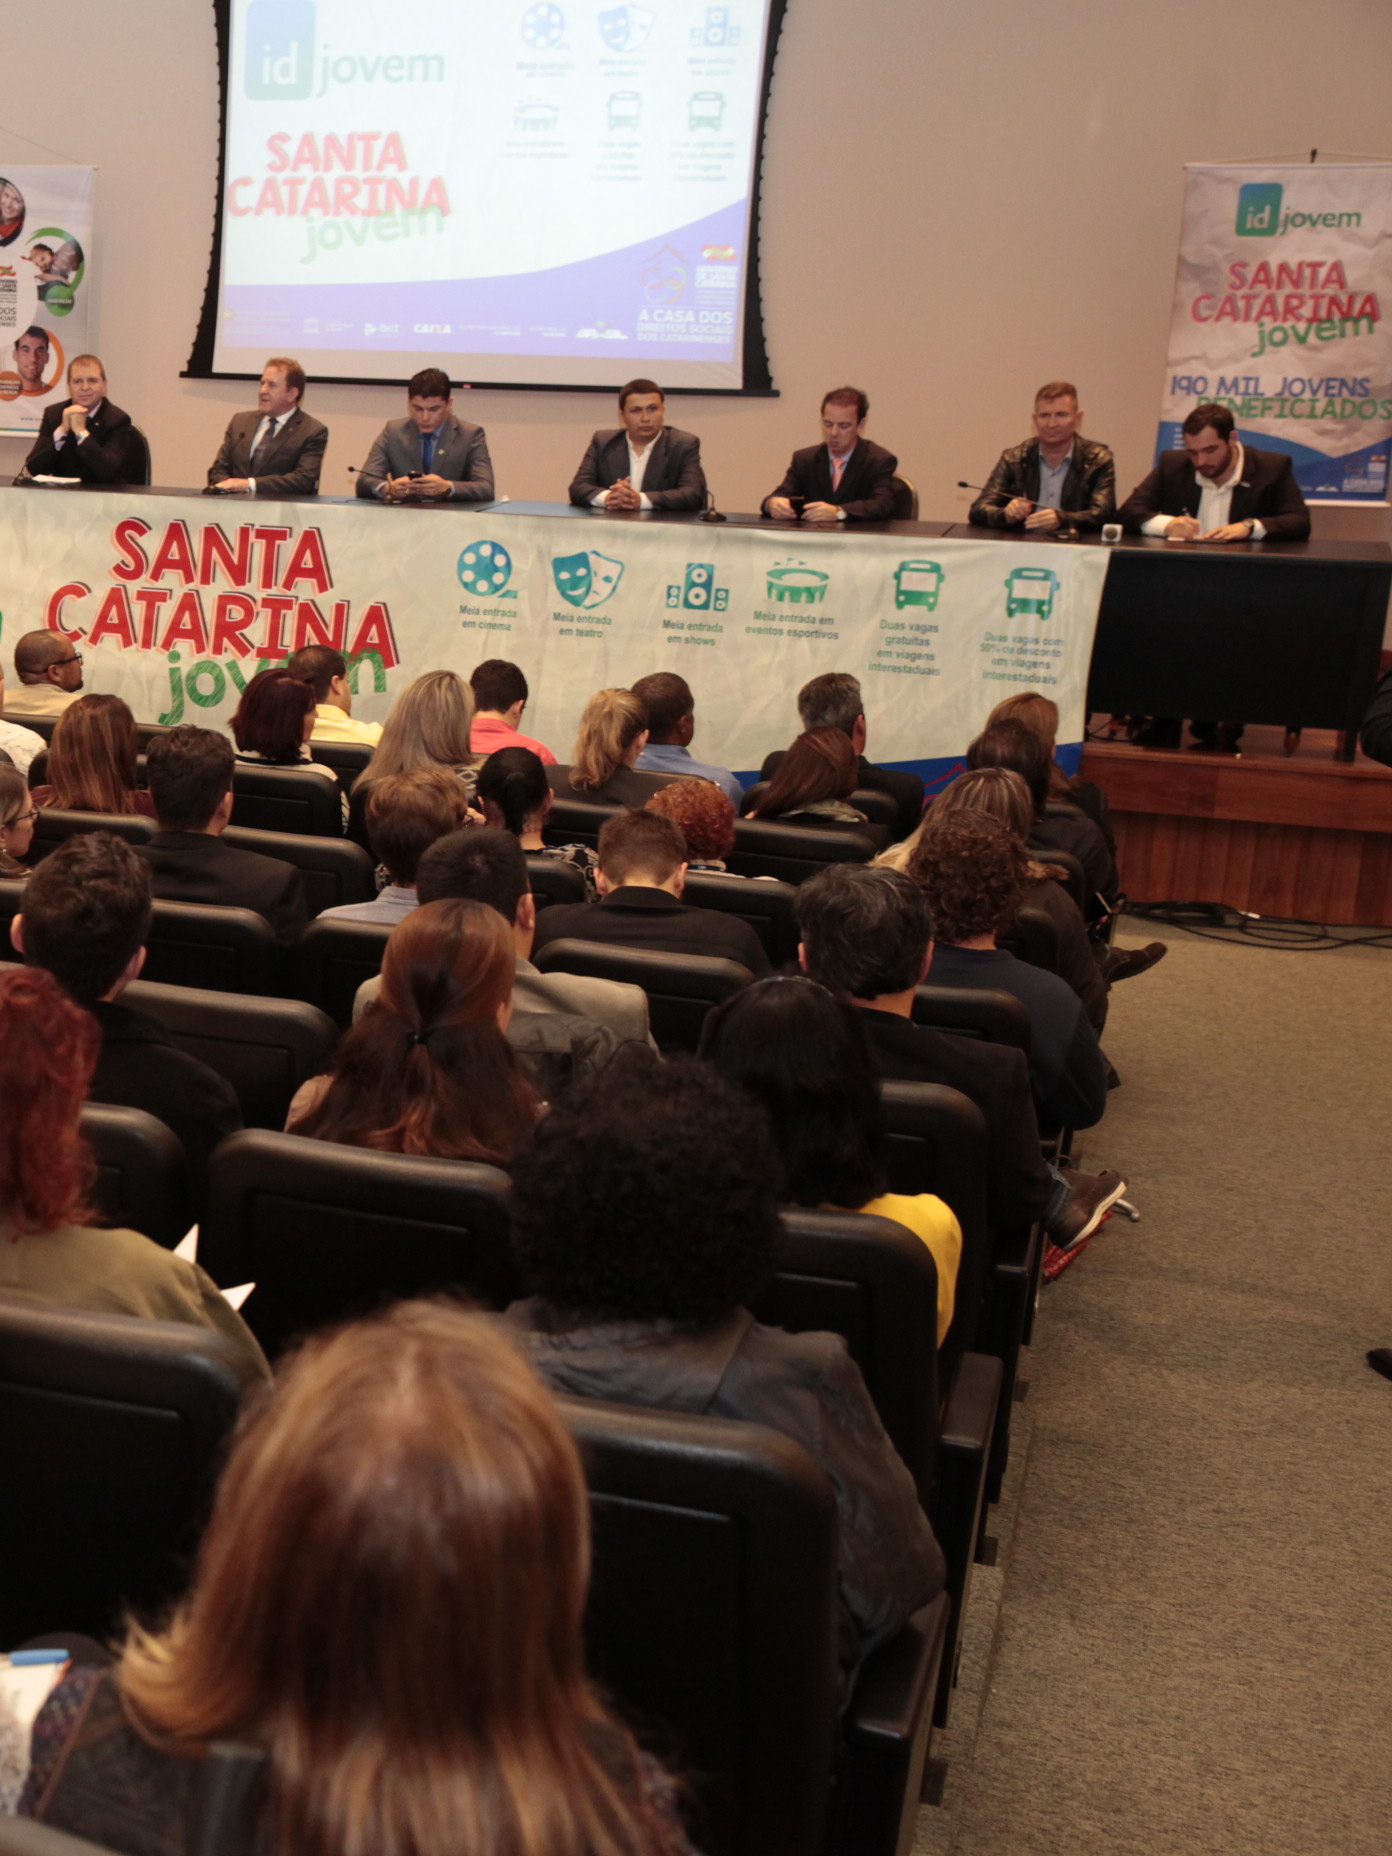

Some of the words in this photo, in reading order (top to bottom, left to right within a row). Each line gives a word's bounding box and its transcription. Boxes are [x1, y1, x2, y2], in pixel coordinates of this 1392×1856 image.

[261, 40, 299, 85] id
[316, 43, 446, 99] jovem
[265, 131, 409, 173] SANTA
[227, 175, 452, 218] CATARINA
[1245, 204, 1271, 229] id
[1279, 206, 1362, 236] jovem
[299, 204, 447, 265] jovem
[1227, 260, 1349, 291] SANTA
[1190, 292, 1381, 324] CATARINA
[639, 309, 649, 322] A
[653, 309, 695, 322] CASA
[698, 311, 734, 324] DOS
[1250, 314, 1375, 358] jovem
[1170, 375, 1208, 396] 190
[1216, 376, 1264, 397] MIL
[1274, 377, 1372, 398] JOVENS
[109, 517, 333, 596] SANTA
[459, 604, 480, 616] Meia
[482, 606, 518, 618] entrada
[553, 612, 574, 623] Meia
[576, 613, 612, 625] entrada
[753, 610, 776, 621] Meia
[778, 612, 816, 624] entrada
[819, 615, 835, 625] em
[45, 582, 401, 671] CATARINA
[462, 620, 476, 629] em
[478, 621, 512, 631] cinema
[558, 626, 573, 636] em
[576, 627, 604, 638] teatro
[662, 619, 685, 630] Meia
[687, 621, 724, 633] entrada
[745, 626, 784, 636] eventos
[786, 626, 840, 640] esportivos
[880, 619, 906, 631] Duas
[908, 622, 939, 634] vagas
[667, 635, 682, 644] em
[684, 635, 716, 646] shows
[884, 635, 931, 647] gratuitas
[984, 632, 1008, 643] Duas
[1011, 635, 1040, 646] vagas
[1042, 637, 1064, 647] com
[876, 649, 893, 658] em
[895, 649, 936, 662] viagens
[1016, 646, 1062, 658] desconto
[868, 662, 941, 676] interestaduais
[991, 657, 1008, 667] em
[1010, 659, 1051, 671] viagens
[982, 670, 1058, 685] interestaduais
[158, 648, 387, 726] jovm
